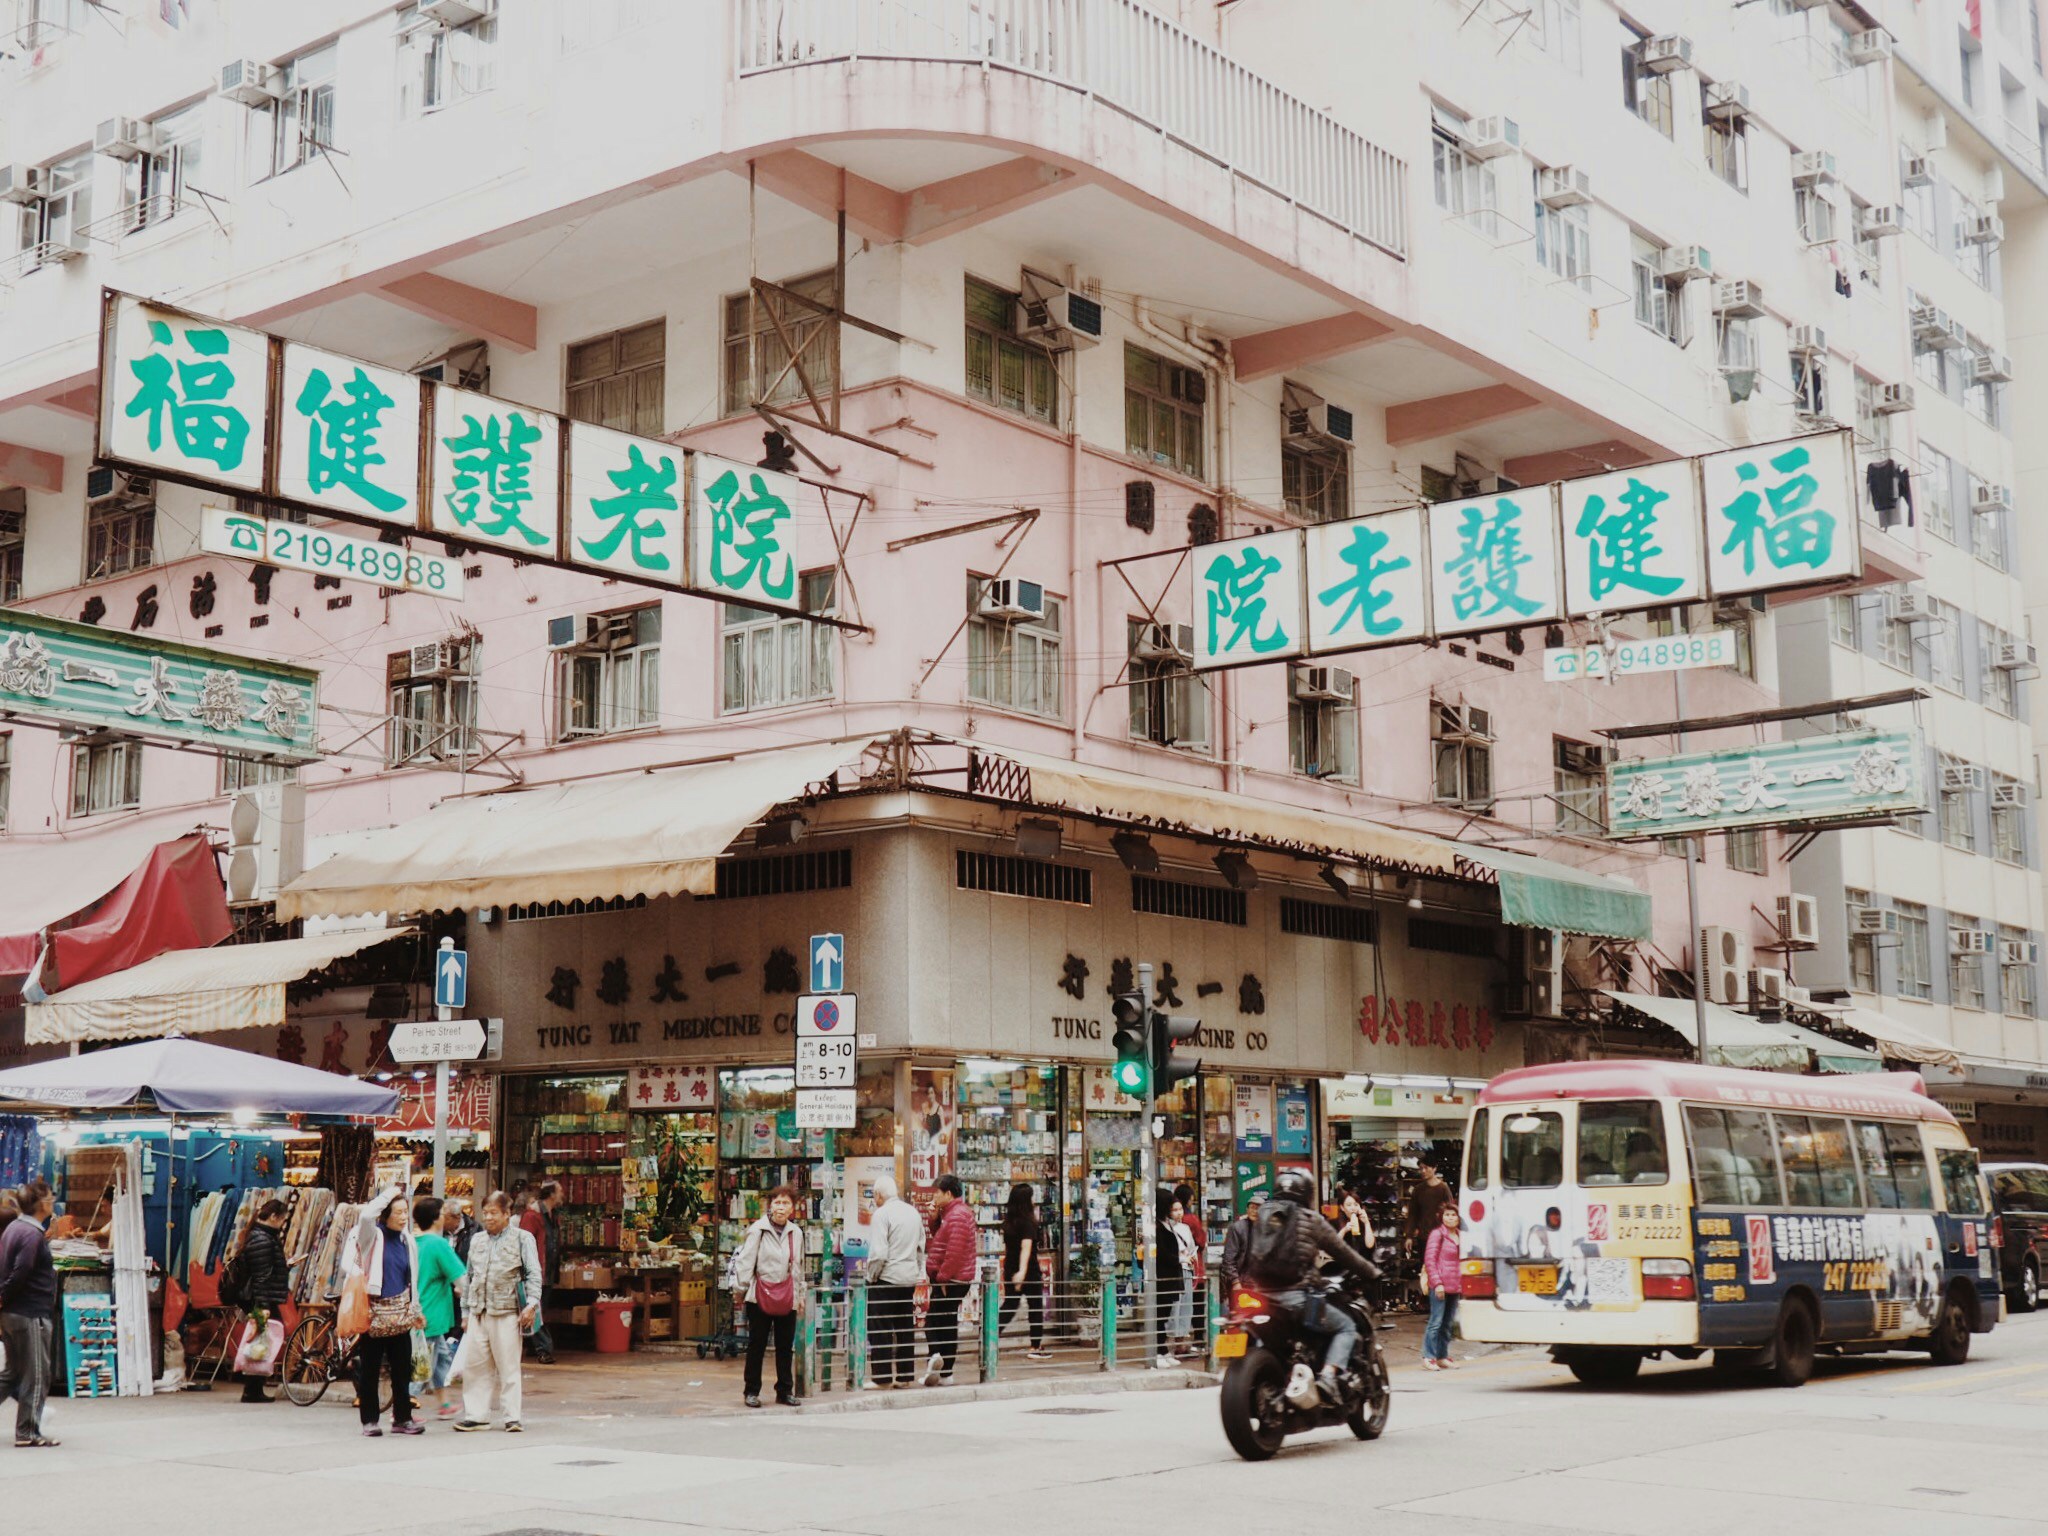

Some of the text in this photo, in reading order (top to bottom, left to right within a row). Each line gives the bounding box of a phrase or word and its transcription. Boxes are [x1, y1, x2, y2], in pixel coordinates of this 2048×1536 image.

[125, 320, 794, 600] 福健護老院
[273, 528, 446, 590] 21948988
[1585, 637, 1723, 672] 2948988
[412, 1026, 461, 1037] Pei Ho Street
[537, 1024, 592, 1049] TUNG
[608, 1021, 642, 1044] YAT
[663, 1013, 761, 1040] MEDICINE
[1051, 1016, 1101, 1040] TUNG
[1246, 1032, 1268, 1051] CO
[420, 1043, 452, 1056] 北河街
[800, 1050, 816, 1059] 上午
[818, 1043, 852, 1057] 8-10
[802, 1064, 813, 1072] pm
[800, 1073, 816, 1082] 下午
[799, 1102, 853, 1111] General Holidays
[1617, 1226, 1640, 1240] 247
[1644, 1226, 1682, 1240] 22222
[1823, 1262, 1848, 1291] 247
